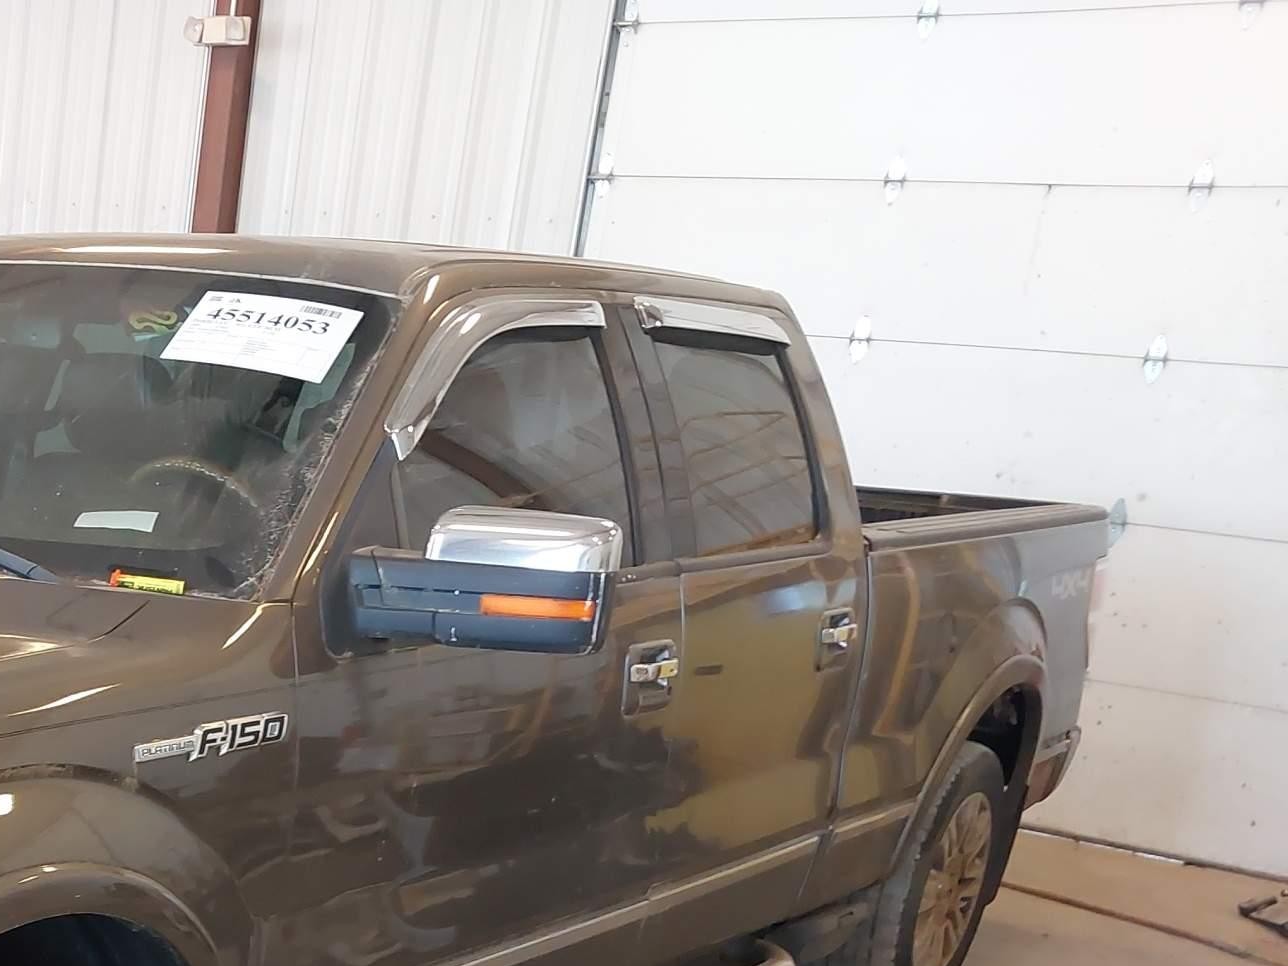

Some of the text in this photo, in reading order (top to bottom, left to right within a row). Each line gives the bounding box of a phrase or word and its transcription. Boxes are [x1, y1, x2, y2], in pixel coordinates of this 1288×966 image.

[206, 307, 331, 335] 45514053
[140, 713, 288, 759] PLATINUM F-150
